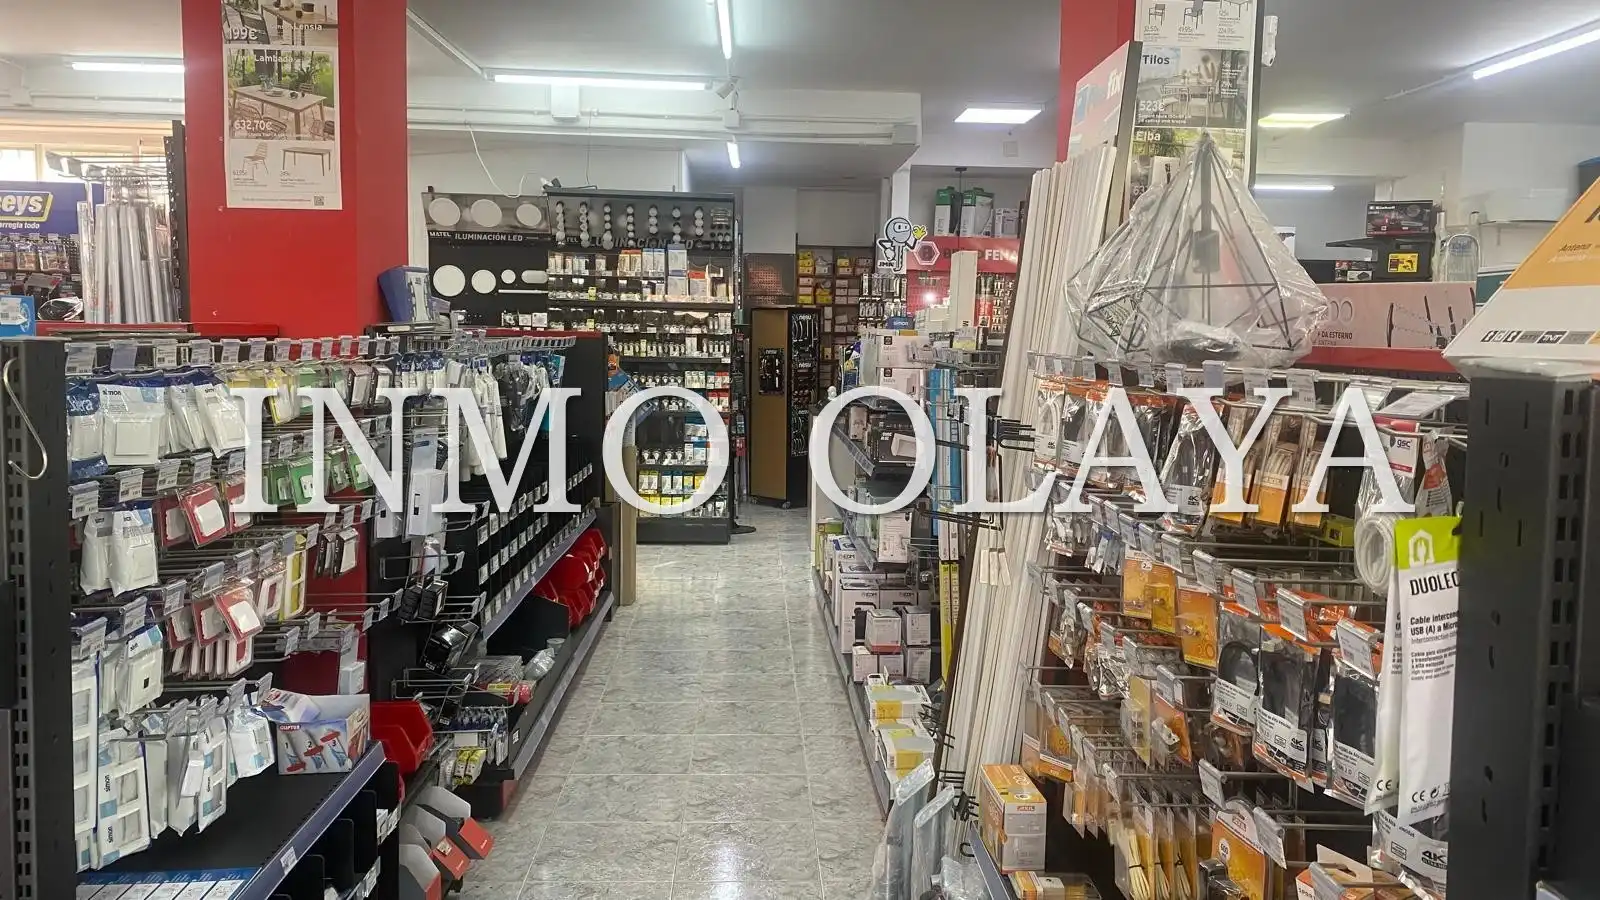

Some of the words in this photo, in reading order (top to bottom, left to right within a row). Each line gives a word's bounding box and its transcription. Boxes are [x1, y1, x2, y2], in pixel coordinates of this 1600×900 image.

[1143, 55, 1170, 65] Tilos
[1140, 101, 1165, 111] 523€
[1136, 131, 1161, 141] Elba
[0, 195, 44, 216] eys
[454, 233, 506, 242] ILUMINACIÓN
[508, 234, 524, 242] LED
[1396, 440, 1411, 448] gsc
[1410, 616, 1431, 626] Cable
[1410, 627, 1424, 636] USB
[1425, 624, 1436, 636] (A)
[1422, 850, 1447, 864] 4K
